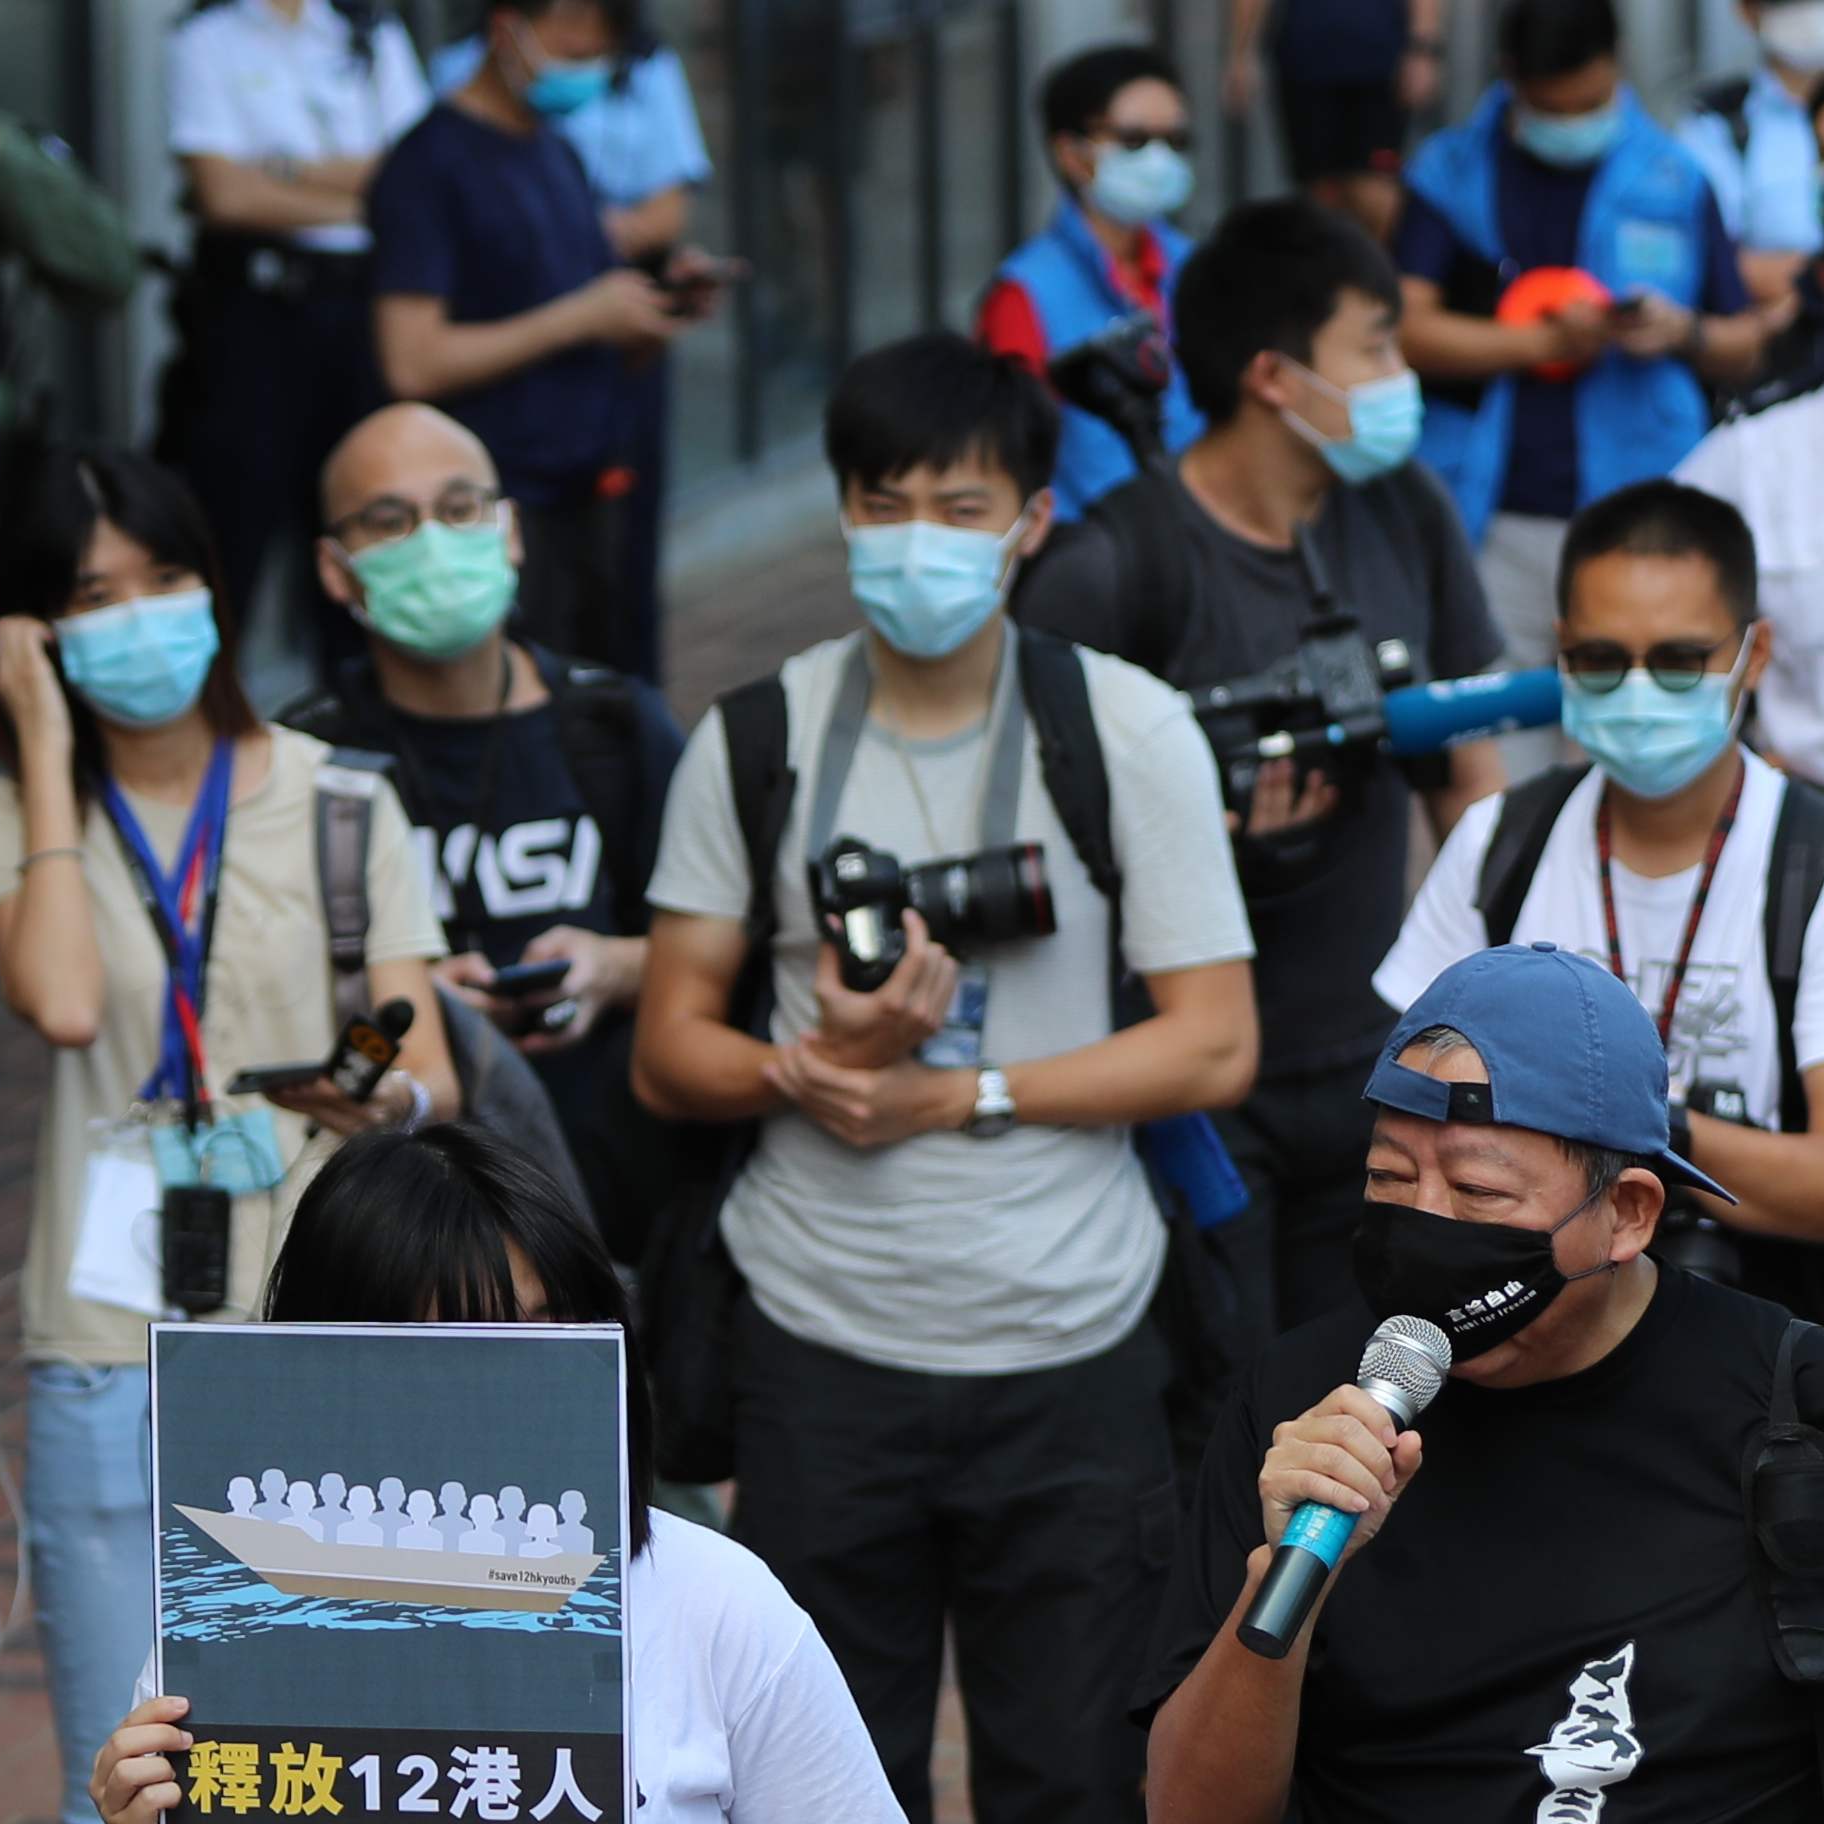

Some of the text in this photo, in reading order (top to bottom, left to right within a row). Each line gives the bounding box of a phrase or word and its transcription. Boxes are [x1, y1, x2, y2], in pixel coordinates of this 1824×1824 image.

[1445, 1281, 1524, 1322] 言論自由
[488, 1568, 577, 1588] #save12hkyouths
[187, 1740, 603, 1822] 釋放12港人
